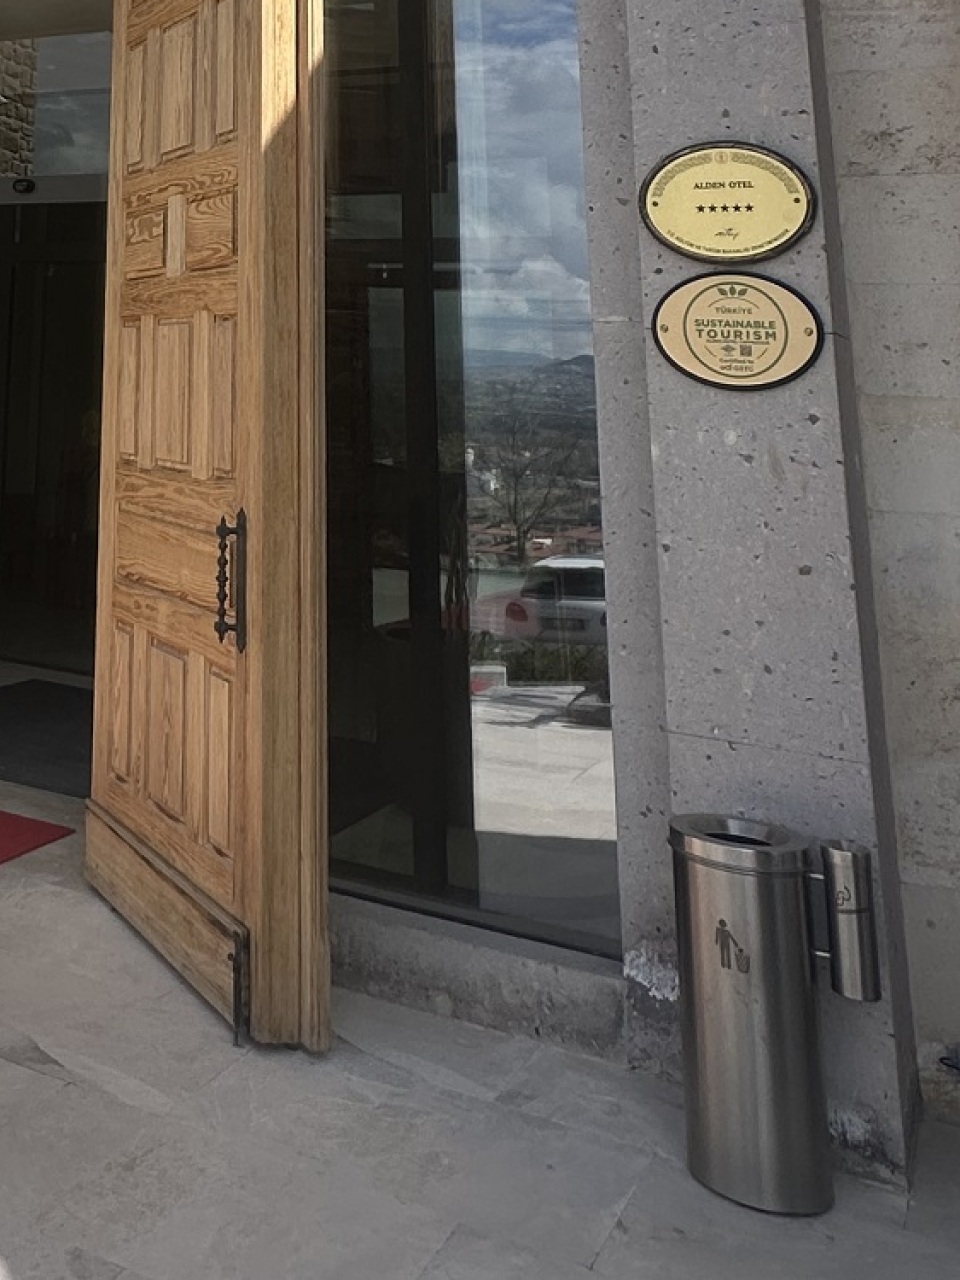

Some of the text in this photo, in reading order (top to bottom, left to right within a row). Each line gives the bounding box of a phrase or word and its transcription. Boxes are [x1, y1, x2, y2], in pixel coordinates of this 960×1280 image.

[728, 180, 754, 189] OTEL
[694, 318, 777, 329] SUSTAINABLE
[695, 328, 777, 342] TOURISM
